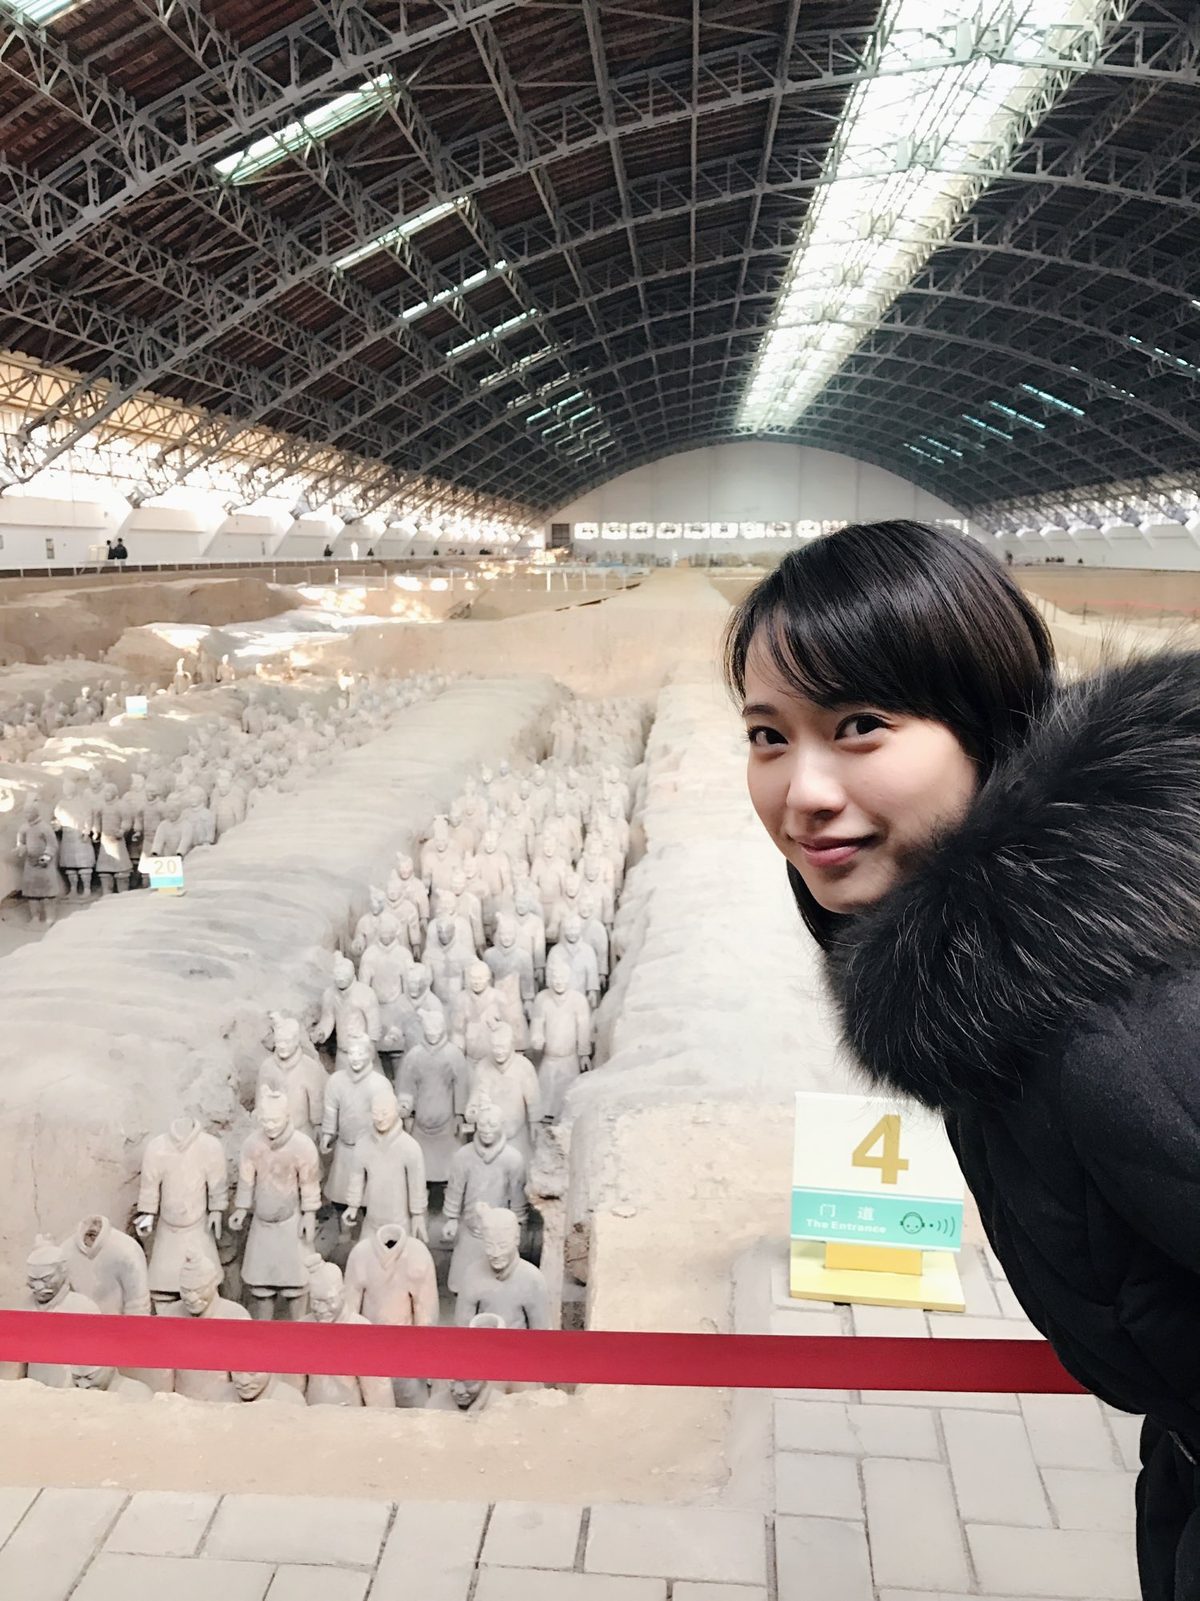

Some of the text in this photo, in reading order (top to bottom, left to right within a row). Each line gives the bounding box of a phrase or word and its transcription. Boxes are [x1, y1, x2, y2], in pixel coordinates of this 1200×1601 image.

[153, 859, 177, 875] 20
[851, 1114, 909, 1185] 4
[805, 1218, 887, 1234] The Entrance
